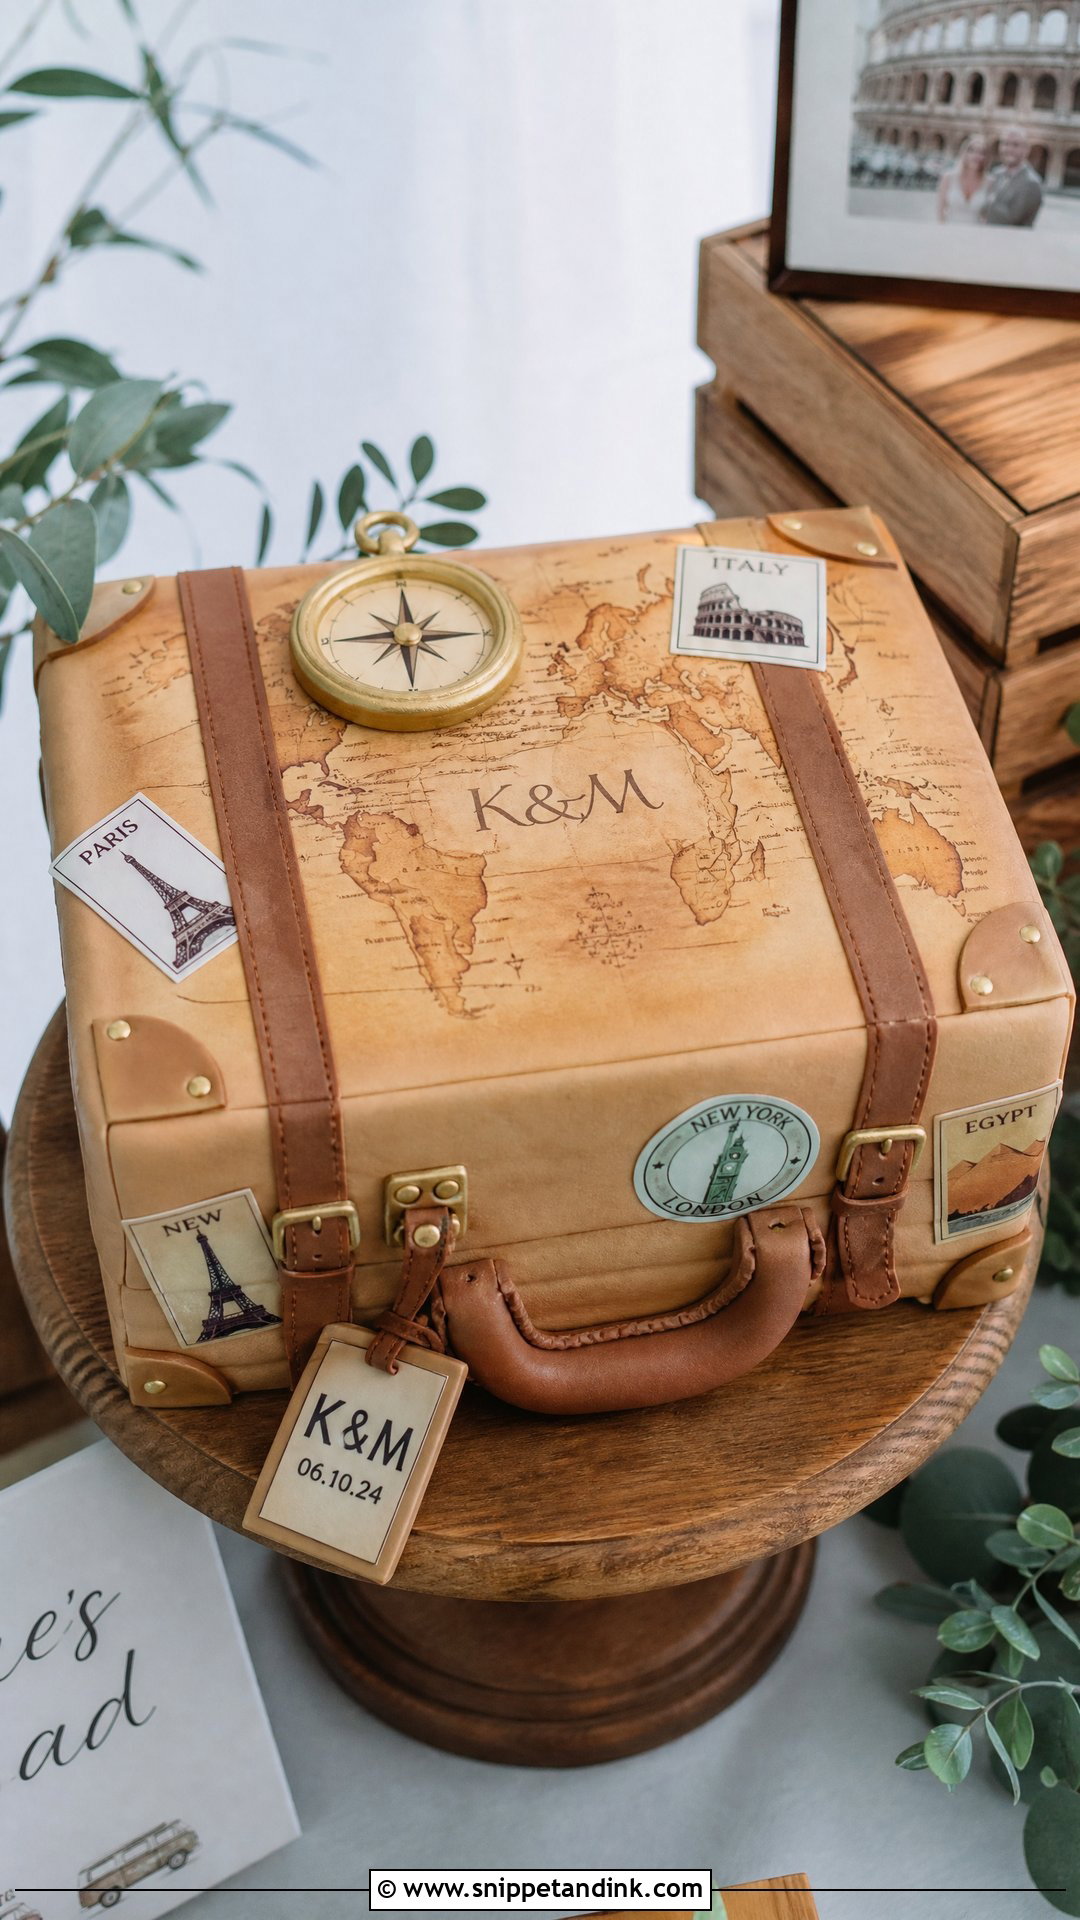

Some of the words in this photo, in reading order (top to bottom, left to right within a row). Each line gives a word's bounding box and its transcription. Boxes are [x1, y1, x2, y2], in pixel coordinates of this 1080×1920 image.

[712, 556, 789, 576] ITALY
[468, 769, 664, 832] K&M
[79, 819, 138, 865] PARIS
[691, 1105, 741, 1133] NEW
[745, 1104, 794, 1130] YORK
[965, 1104, 1037, 1134] EGYPT
[162, 1209, 222, 1237] NEW
[662, 1192, 764, 1216] LONDON
[303, 1393, 414, 1472] K&M
[297, 1457, 384, 1505] 06.10.24
[0, 1589, 121, 1682] e's
